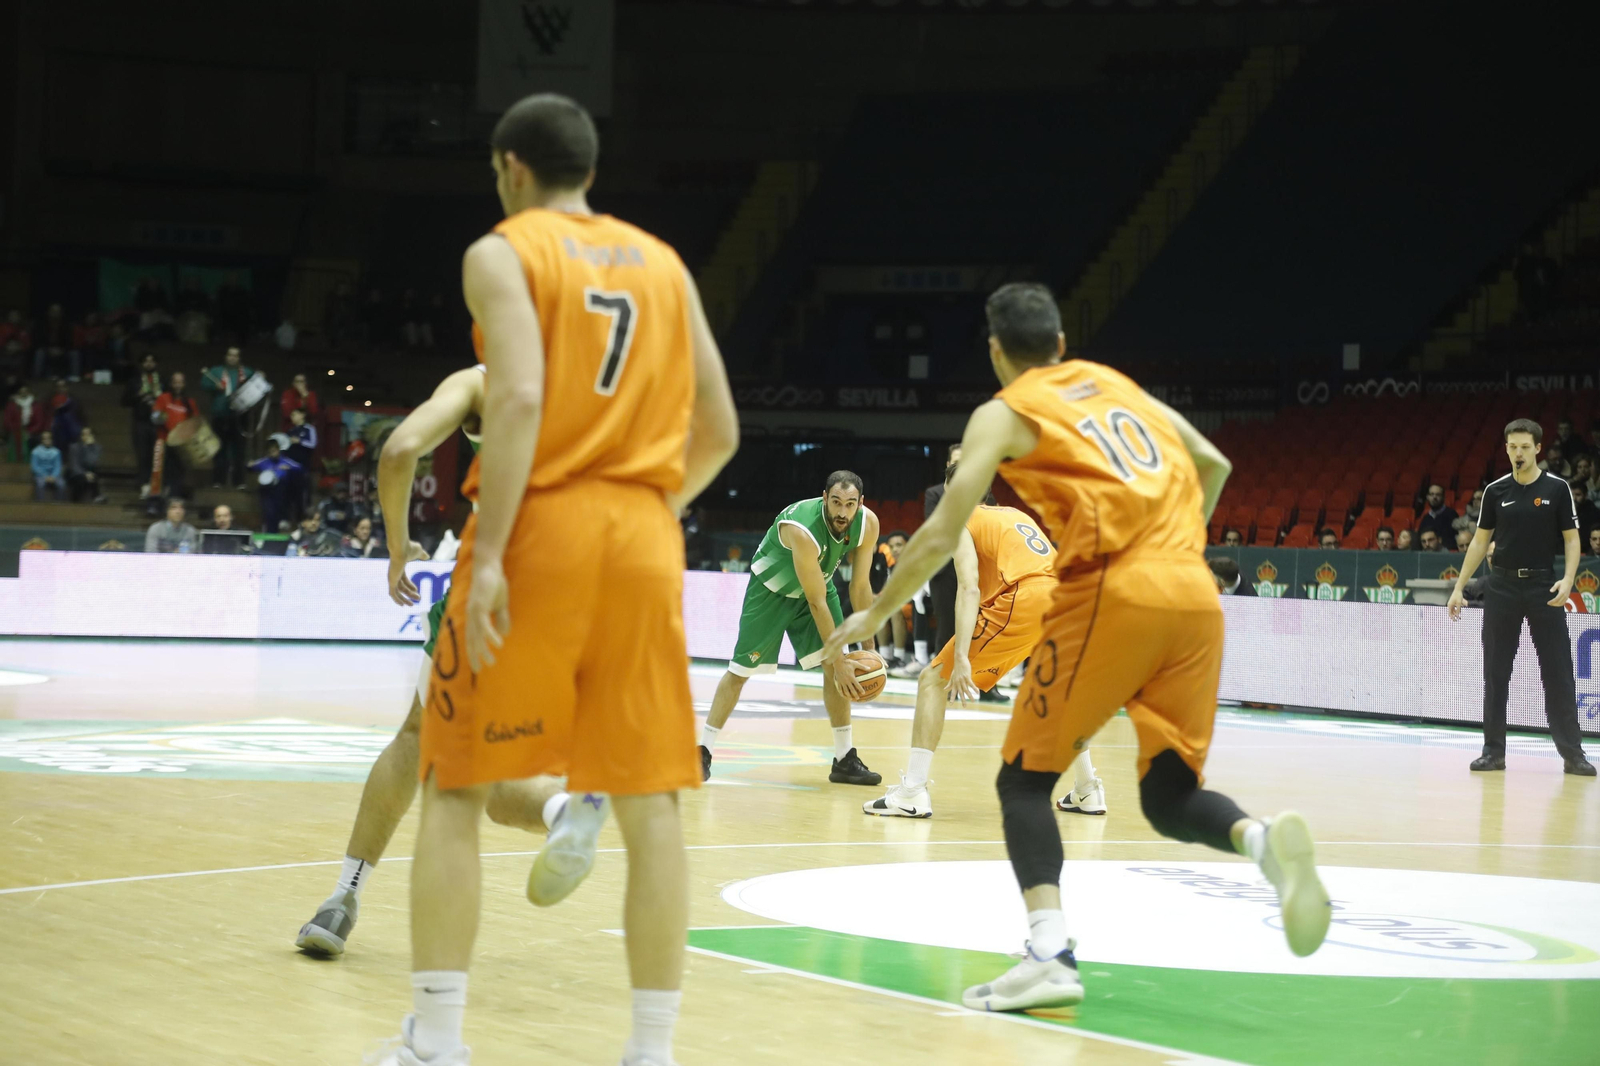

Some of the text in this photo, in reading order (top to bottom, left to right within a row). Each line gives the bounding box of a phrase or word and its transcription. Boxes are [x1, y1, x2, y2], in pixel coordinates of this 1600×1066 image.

[583, 286, 639, 398] 7
[838, 387, 919, 407] SEVILLA
[1076, 407, 1163, 481] 10
[1015, 523, 1050, 556] 8
[1331, 918, 1509, 950] plus
